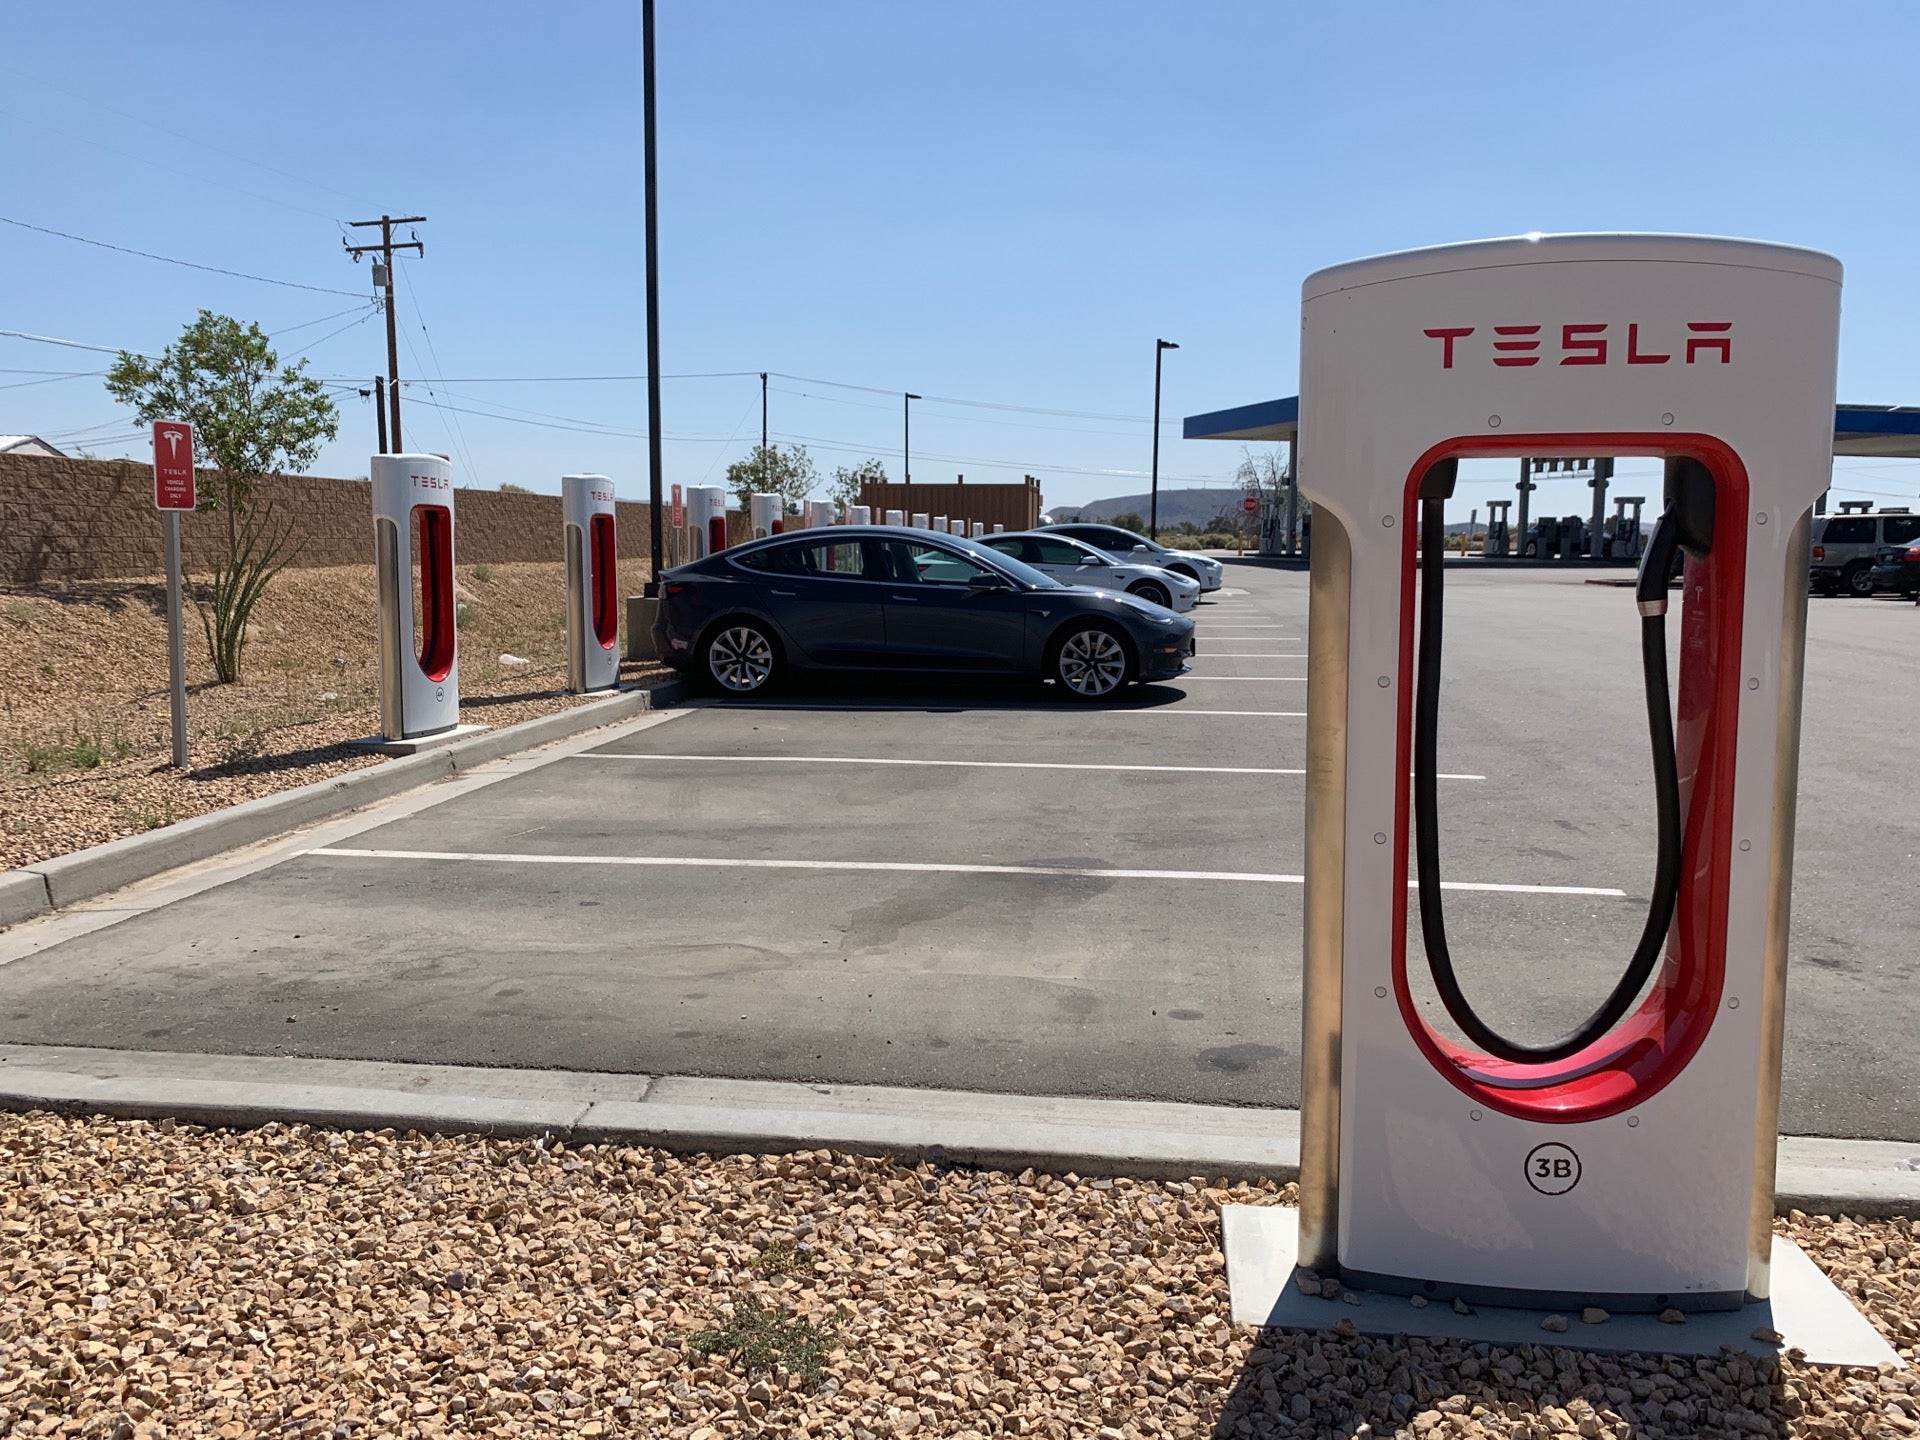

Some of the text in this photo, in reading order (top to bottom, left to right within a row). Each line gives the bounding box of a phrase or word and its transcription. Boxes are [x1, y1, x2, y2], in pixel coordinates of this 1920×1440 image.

[1423, 322, 1733, 369] TESLA
[163, 468, 187, 476] TESLA
[410, 475, 449, 490] TESLA
[1534, 1158, 1572, 1178] 3B
